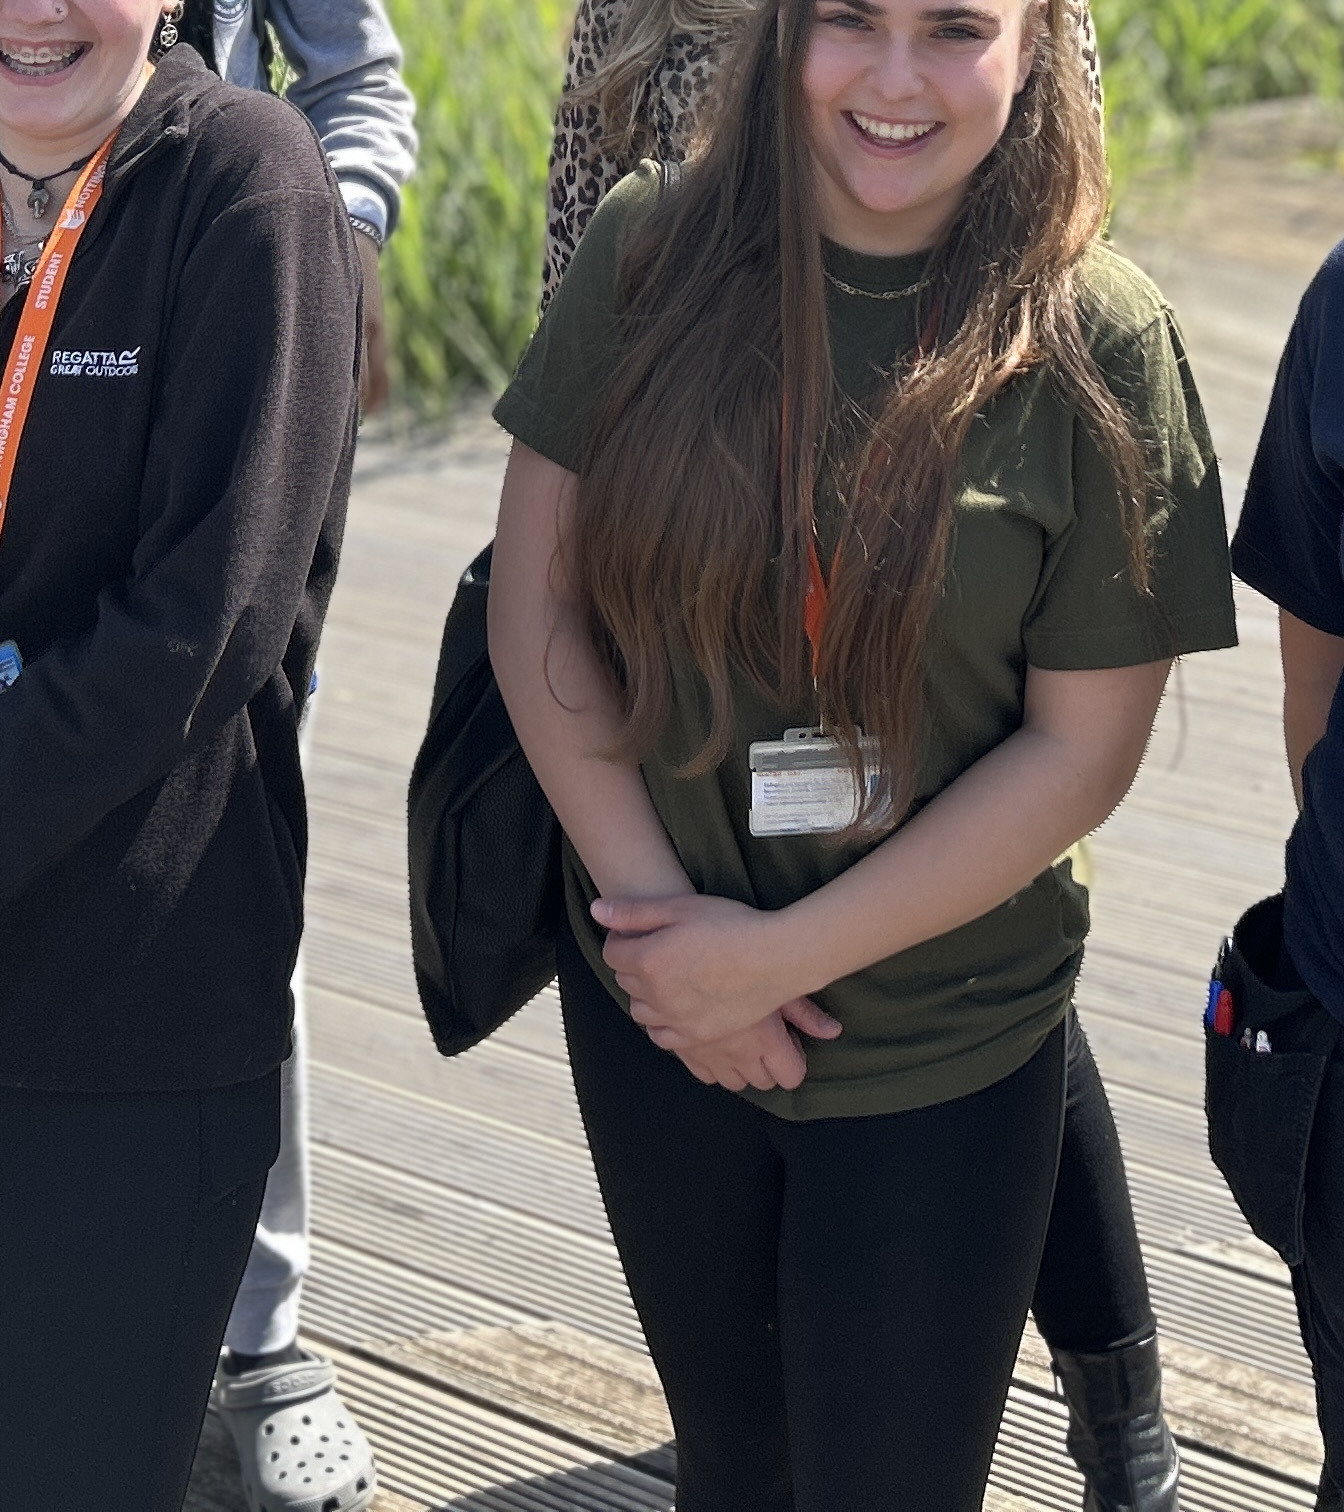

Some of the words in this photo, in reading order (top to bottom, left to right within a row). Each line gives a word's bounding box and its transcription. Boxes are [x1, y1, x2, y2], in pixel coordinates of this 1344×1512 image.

[35, 253, 64, 310] STUDENT
[9, 335, 36, 396] COLLEGE
[52, 350, 118, 366] REGATTA
